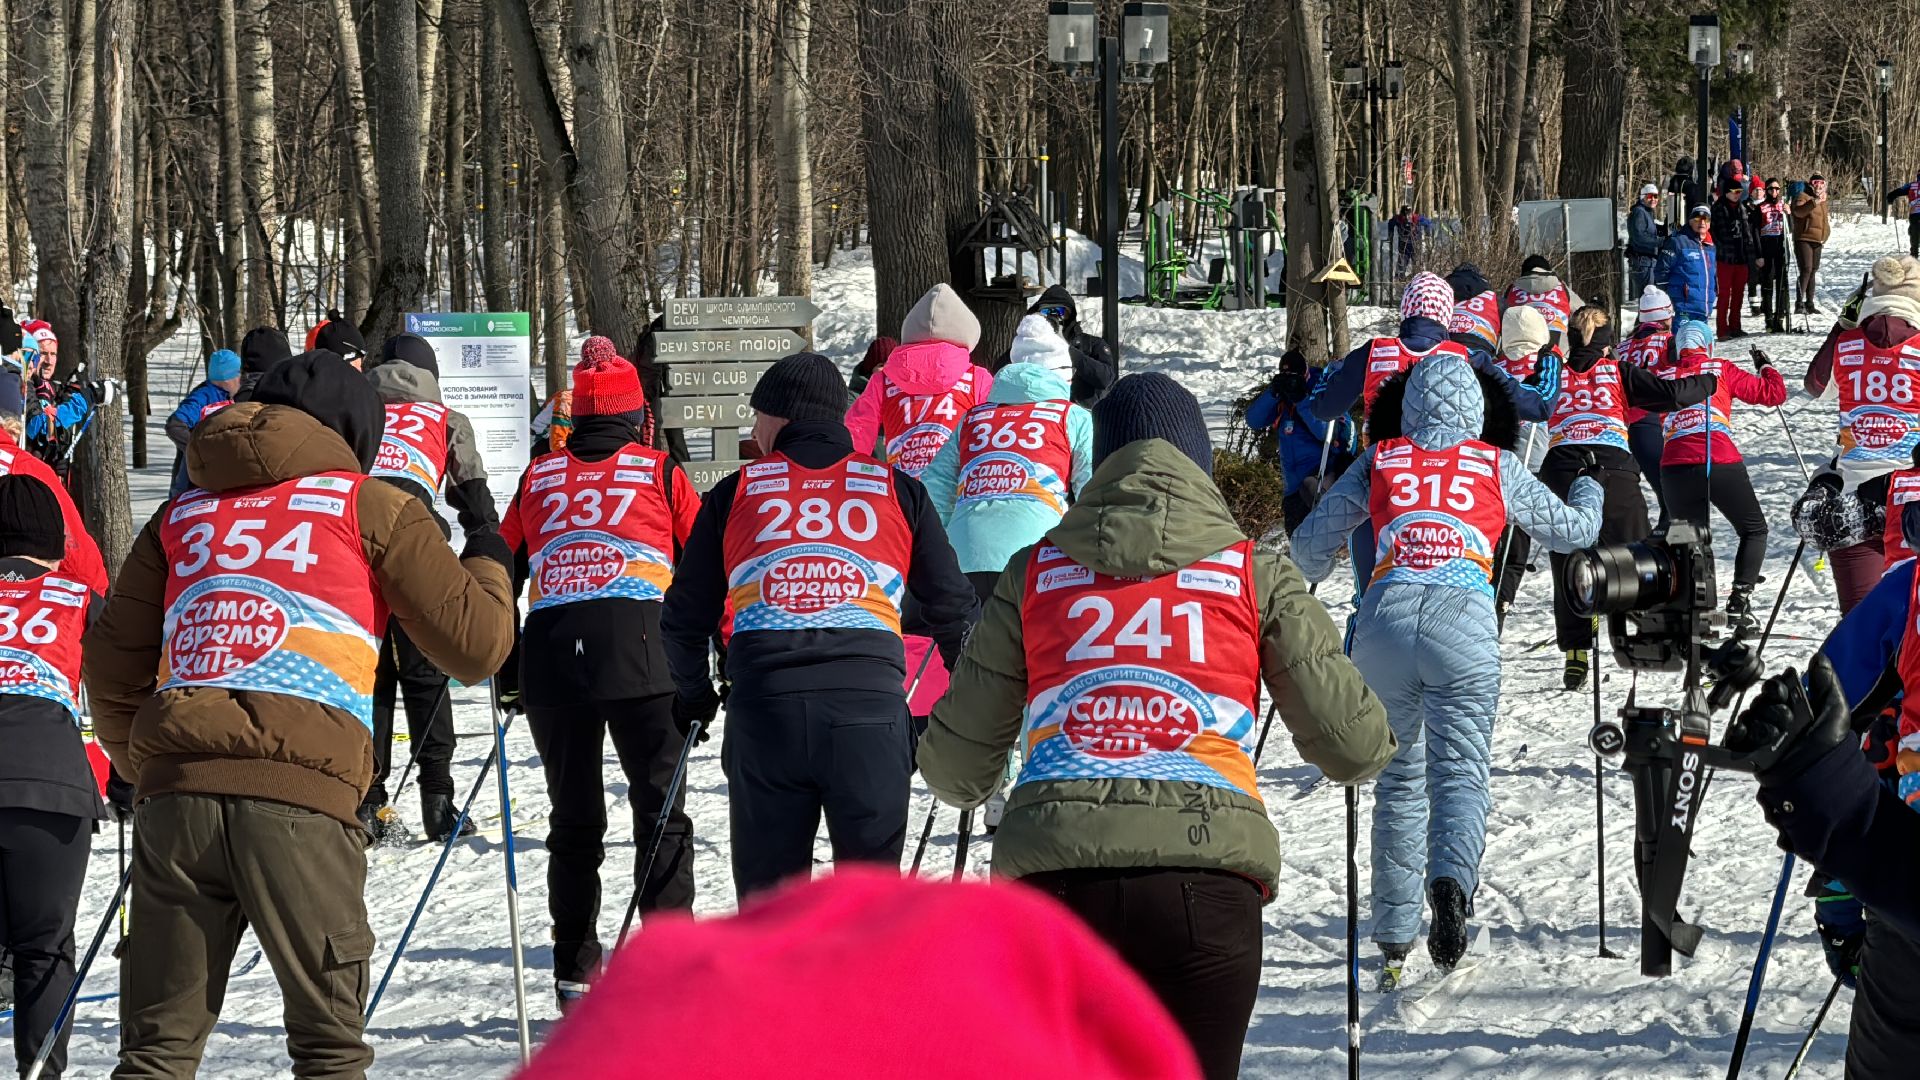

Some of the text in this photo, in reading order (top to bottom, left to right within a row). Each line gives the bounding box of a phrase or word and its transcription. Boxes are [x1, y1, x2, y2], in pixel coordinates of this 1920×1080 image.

[673, 303, 699, 315] DEVI
[673, 315, 699, 325] CLUB
[706, 303, 733, 314] ШКОЛА
[721, 315, 770, 325] ЧЕМПИОНА
[660, 337, 791, 353] DEVI STORE maloja
[674, 372, 705, 386] DEVI
[713, 371, 747, 385] CLUB
[1848, 370, 1913, 404] 188
[470, 392, 498, 400] ЗИМНИЙ
[898, 392, 958, 425] 174
[1556, 386, 1615, 415] 233
[683, 405, 723, 420] DEVI
[968, 422, 1045, 452] 363
[694, 470, 708, 483] 50
[1389, 472, 1475, 512] 315
[539, 488, 637, 535] 237
[754, 498, 878, 543] 280
[175, 519, 319, 578] 354
[1065, 595, 1206, 664] 241
[1064, 670, 1214, 721] БЛАГОТВОРИТЕЛЬНАЯ ЛЫЖНЯ
[1671, 751, 1699, 835] SONY
